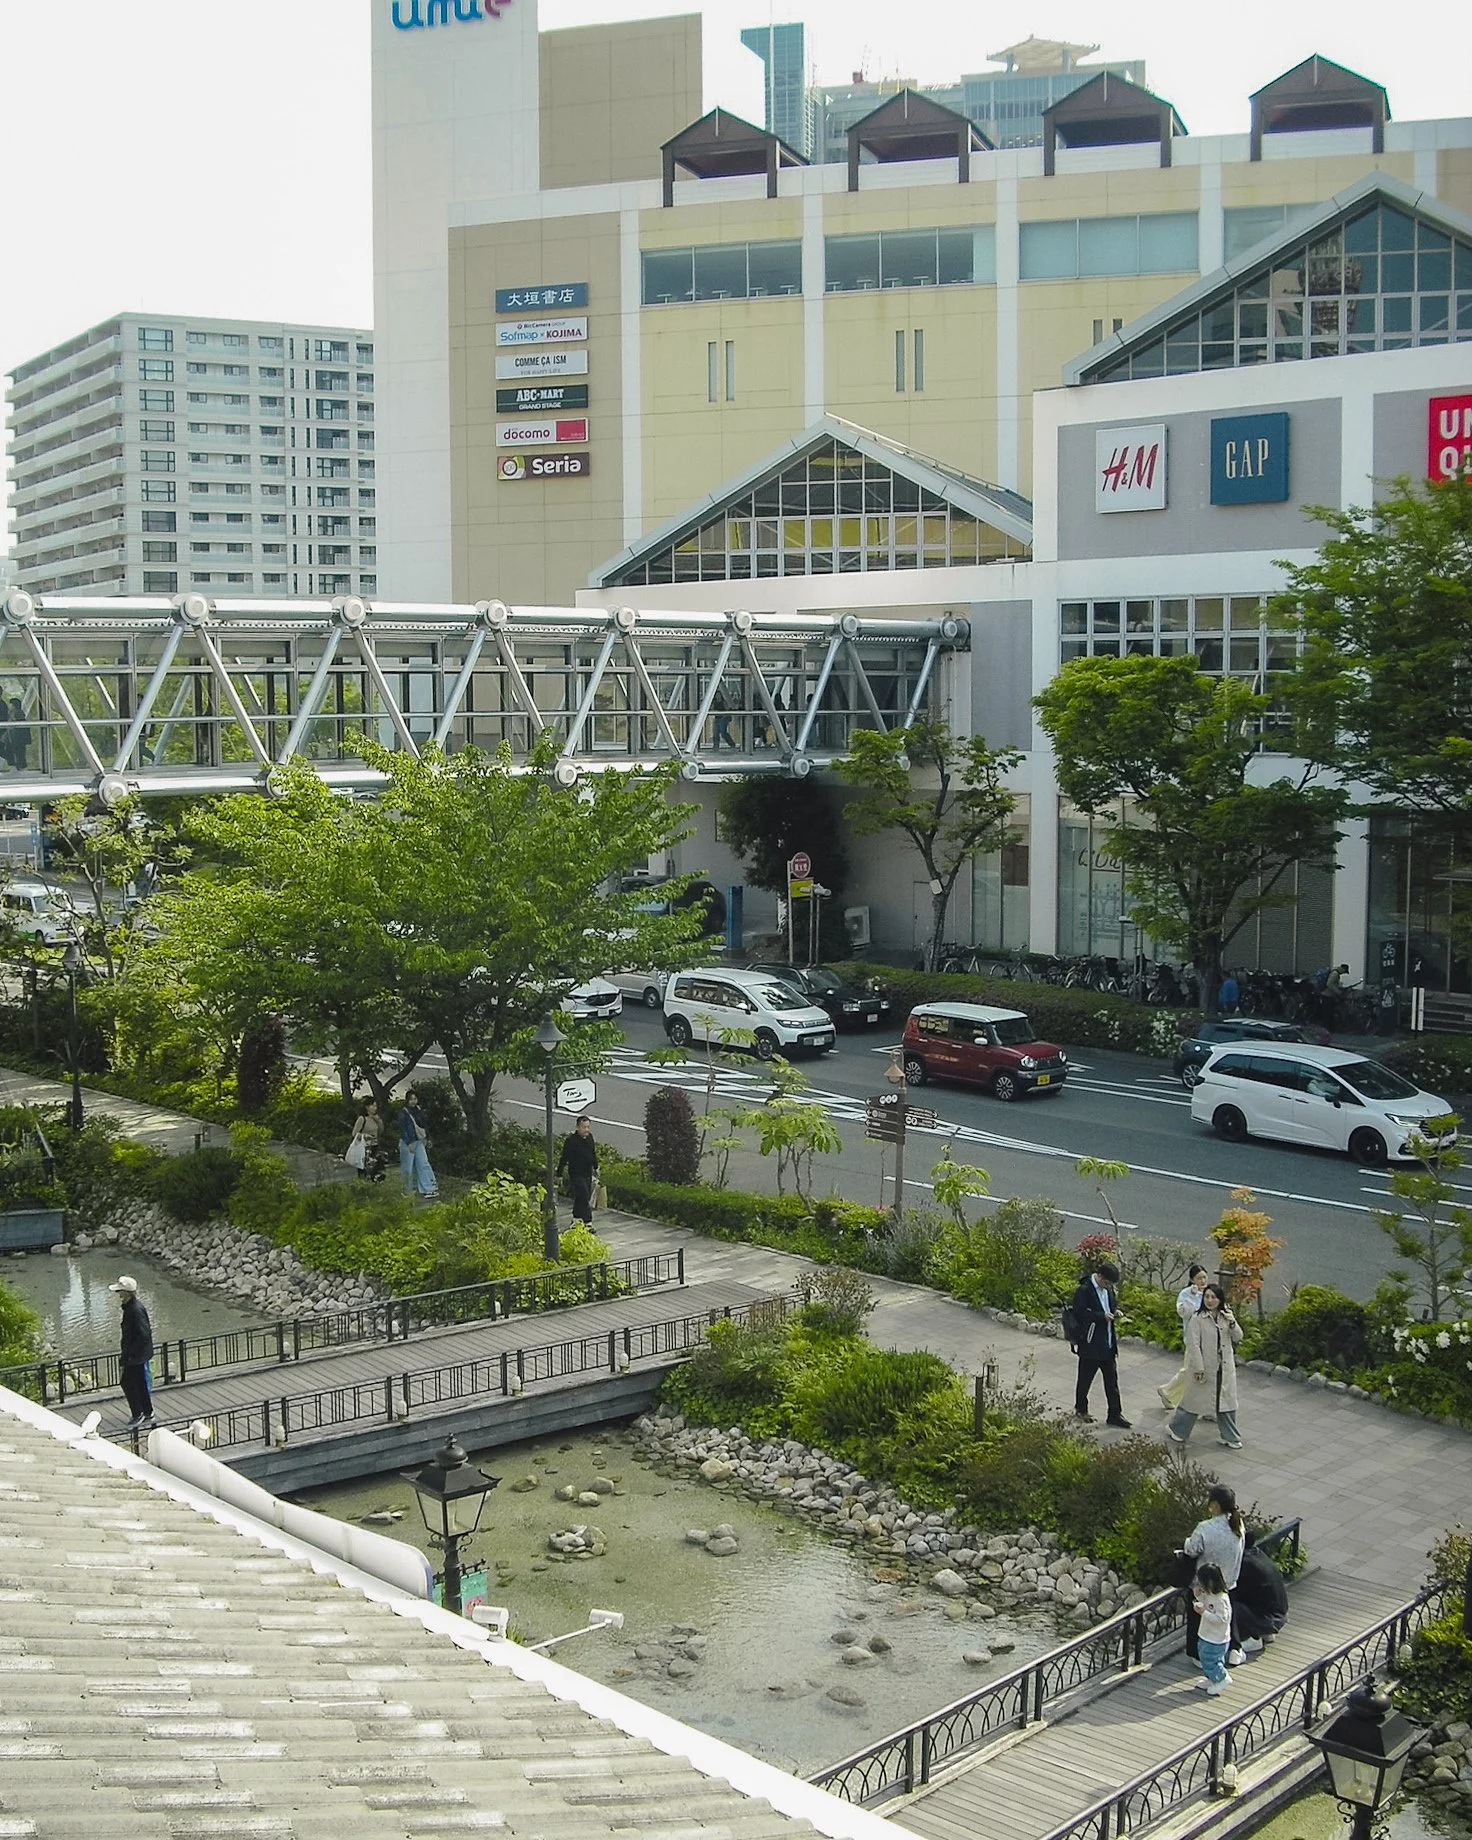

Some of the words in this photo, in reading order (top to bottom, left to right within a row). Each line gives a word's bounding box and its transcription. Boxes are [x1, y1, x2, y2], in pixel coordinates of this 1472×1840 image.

[507, 288, 575, 306] 大垣書店
[500, 330, 538, 341] Sofmap
[546, 328, 582, 338] KOJIMA
[515, 357, 540, 367] COMME
[553, 355, 567, 365] ISM
[503, 428, 550, 440] docomo
[532, 455, 581, 475] Seria
[1102, 443, 1159, 492] H&M
[1226, 438, 1269, 479] GAP
